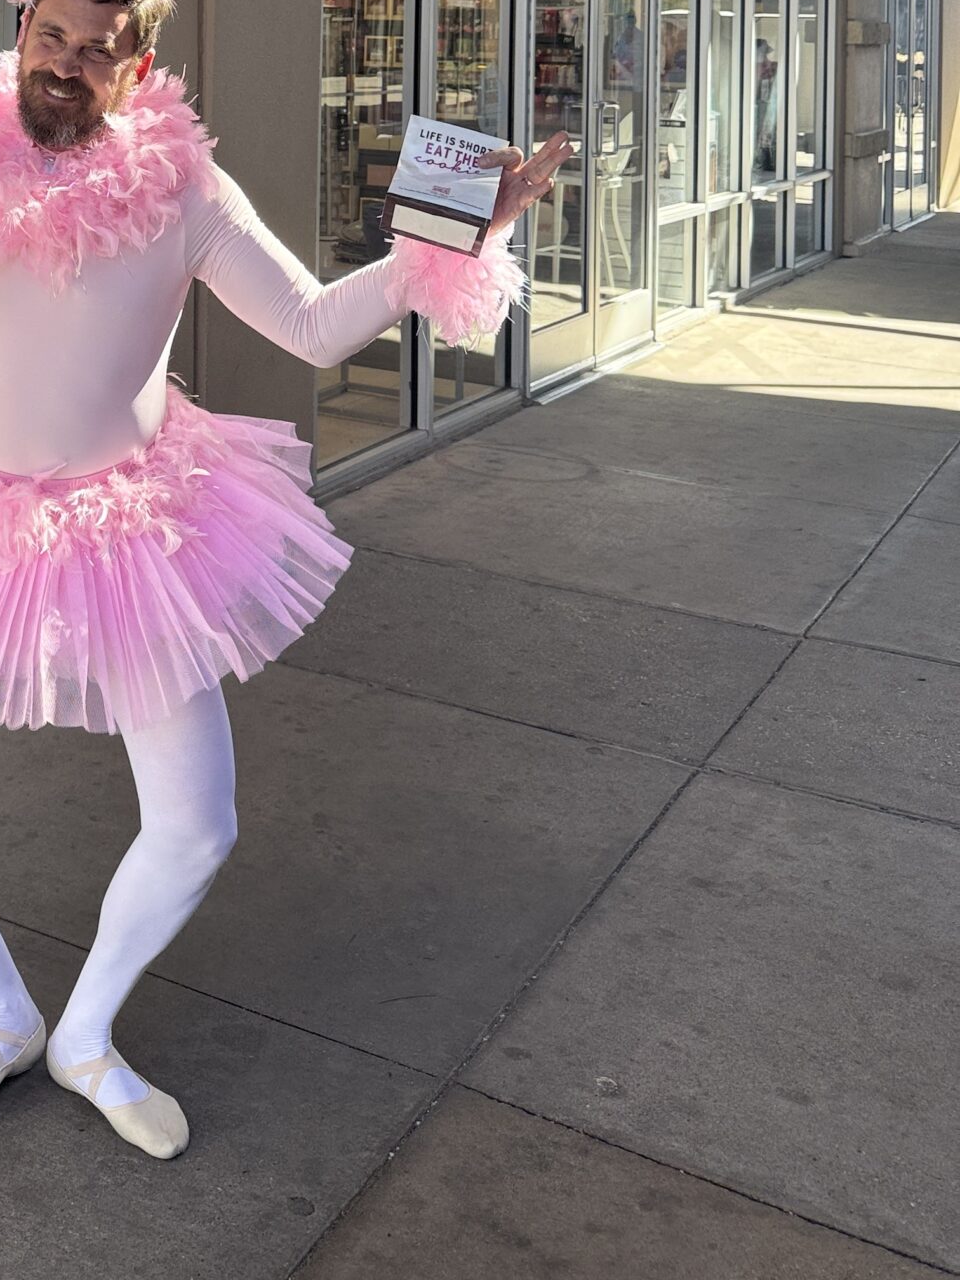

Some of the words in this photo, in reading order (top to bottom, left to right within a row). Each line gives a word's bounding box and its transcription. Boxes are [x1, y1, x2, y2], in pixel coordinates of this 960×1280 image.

[419, 129, 442, 142] LIFE
[445, 135, 456, 146] IS
[425, 142, 452, 159] EAT
[455, 150, 480, 168] THE
[414, 156, 487, 175] cookie
